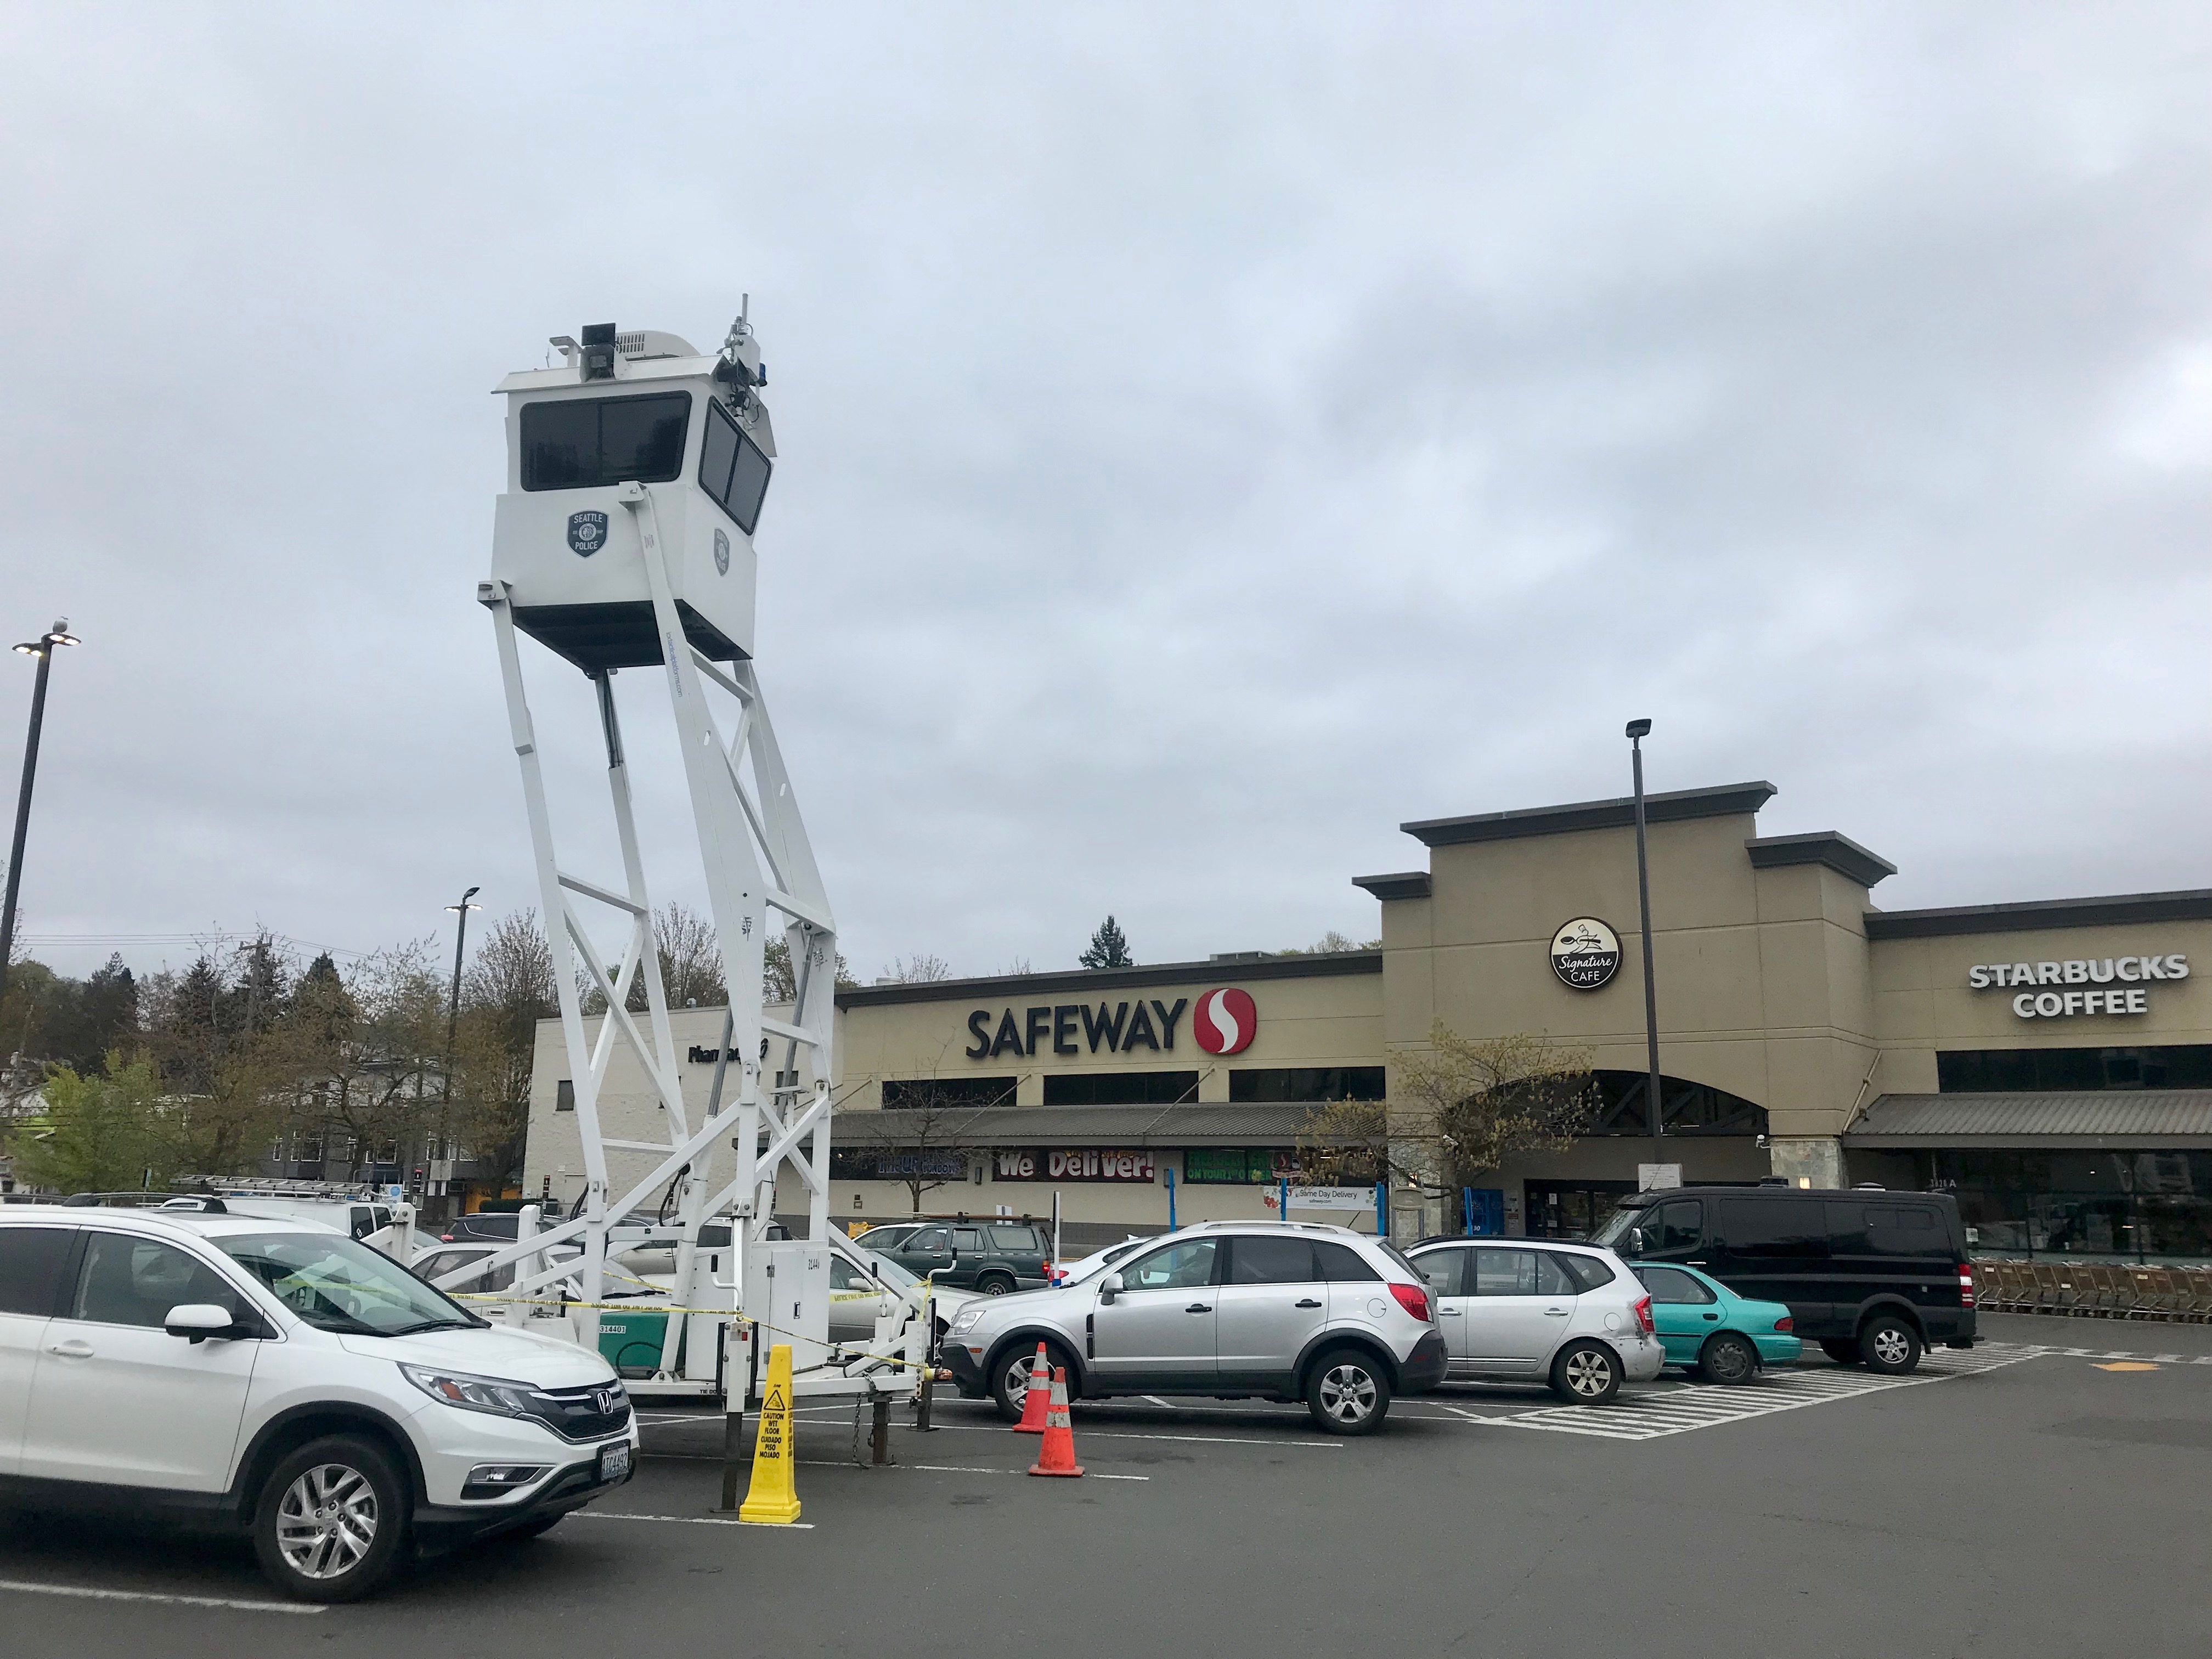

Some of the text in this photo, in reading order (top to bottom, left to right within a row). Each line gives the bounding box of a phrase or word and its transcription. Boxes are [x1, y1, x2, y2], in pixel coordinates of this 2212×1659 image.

[574, 513, 603, 523] SEATTLE
[575, 540, 598, 550] POLICE
[1559, 955, 1613, 973] Signature
[1968, 953, 2190, 988] STARBUCKS
[1571, 970, 1600, 982] CAFE
[2012, 989, 2148, 1018] COFFEE
[966, 998, 1188, 1058] SAFEWAY
[998, 1152, 1034, 1176] We
[1318, 1190, 1330, 1199] Day
[1331, 1190, 1358, 1199] Delivery
[760, 1436, 782, 1444] CUIDADO
